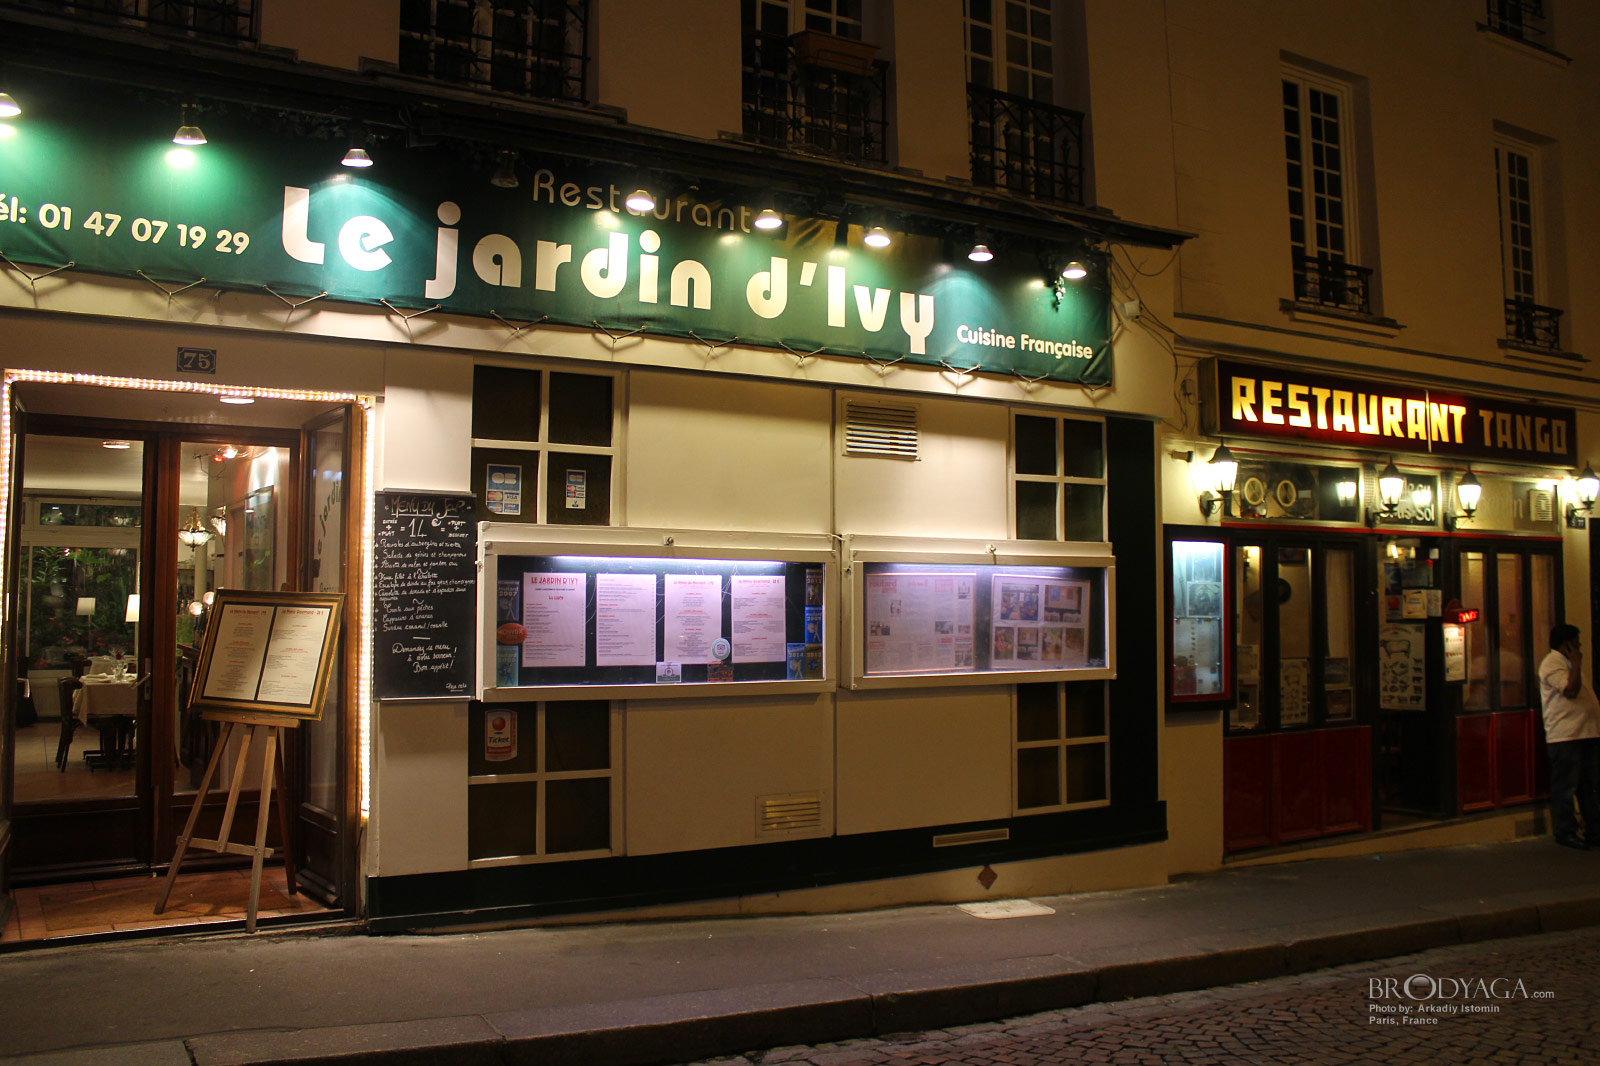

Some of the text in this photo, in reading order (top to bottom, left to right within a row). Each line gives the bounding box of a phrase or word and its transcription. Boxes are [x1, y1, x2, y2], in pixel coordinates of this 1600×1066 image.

[533, 169, 750, 233] Resturant
[38, 203, 71, 231] 01
[83, 211, 121, 237] 47
[131, 217, 168, 243] 07
[176, 224, 206, 249] 19
[215, 229, 250, 254] 29
[281, 185, 935, 354] Le jardin d'Ivy
[184, 352, 210, 369] 75
[956, 324, 1093, 359] Cuisine Française
[1231, 376, 1567, 455] RESTAURANT TANGO
[531, 577, 579, 585] LE JARDIN D'IVY
[488, 736, 510, 744] Ticket
